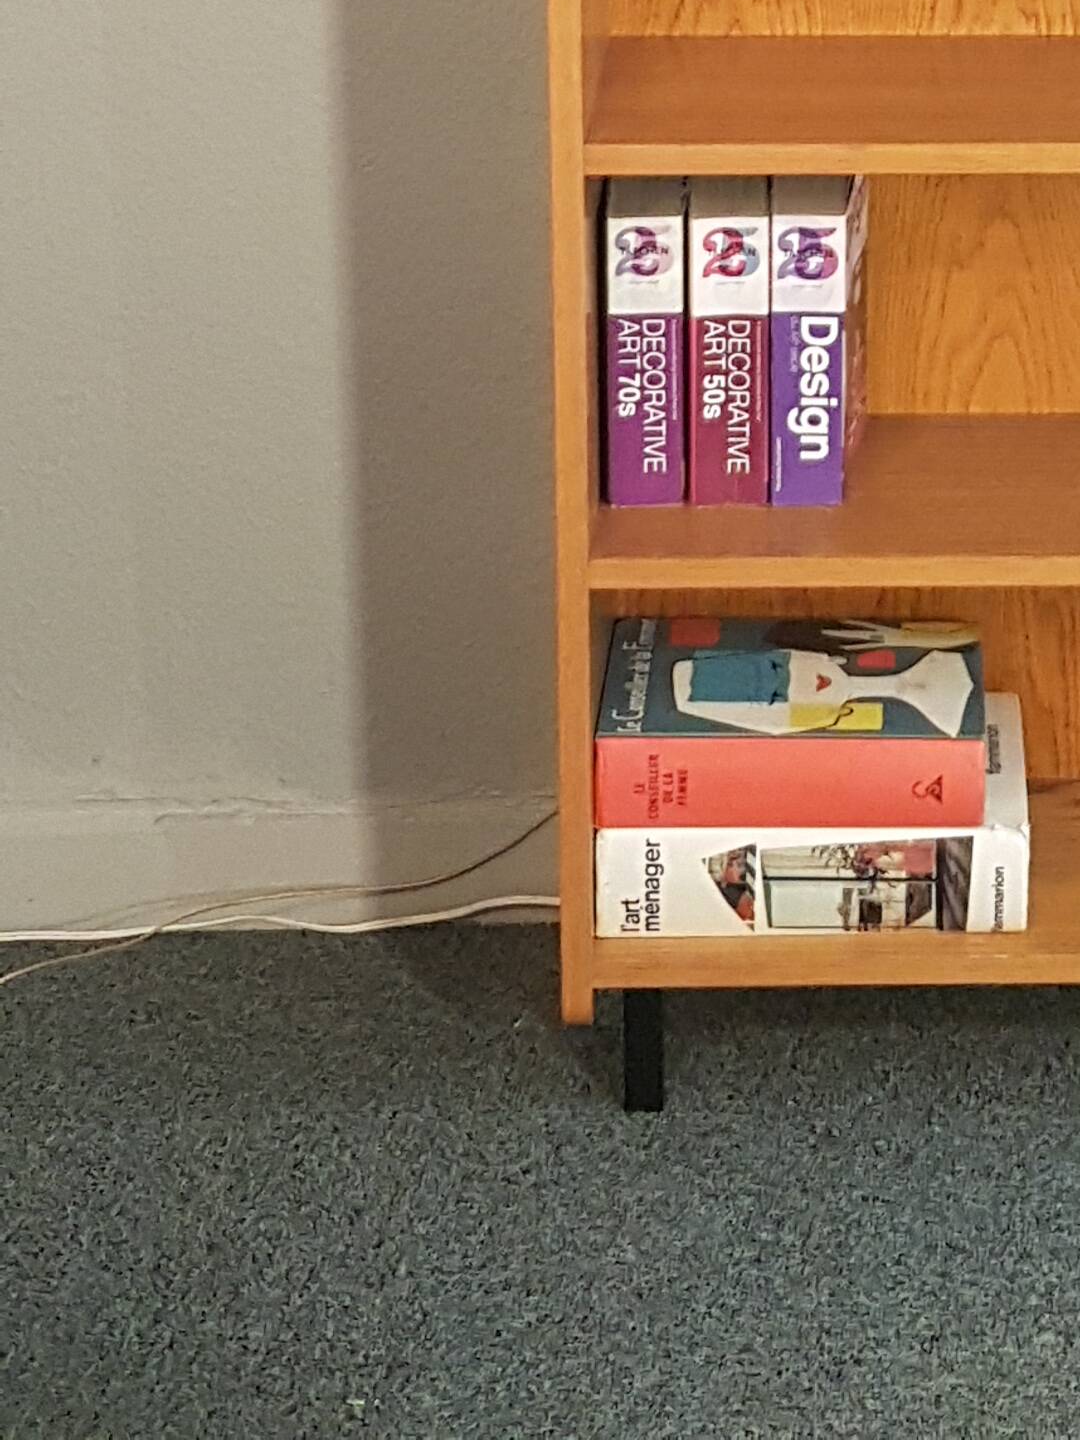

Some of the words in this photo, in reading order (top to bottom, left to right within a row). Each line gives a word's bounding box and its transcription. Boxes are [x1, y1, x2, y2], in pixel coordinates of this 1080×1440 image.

[617, 318, 641, 370] ART
[703, 320, 727, 370] ART
[617, 372, 641, 417] 70s
[643, 318, 667, 473] DECORATIVE
[702, 374, 726, 420] 50s
[727, 319, 751, 474] DECORATIVE
[787, 315, 839, 461] Design
[639, 838, 665, 932] ménager
[619, 897, 640, 933] l'art
